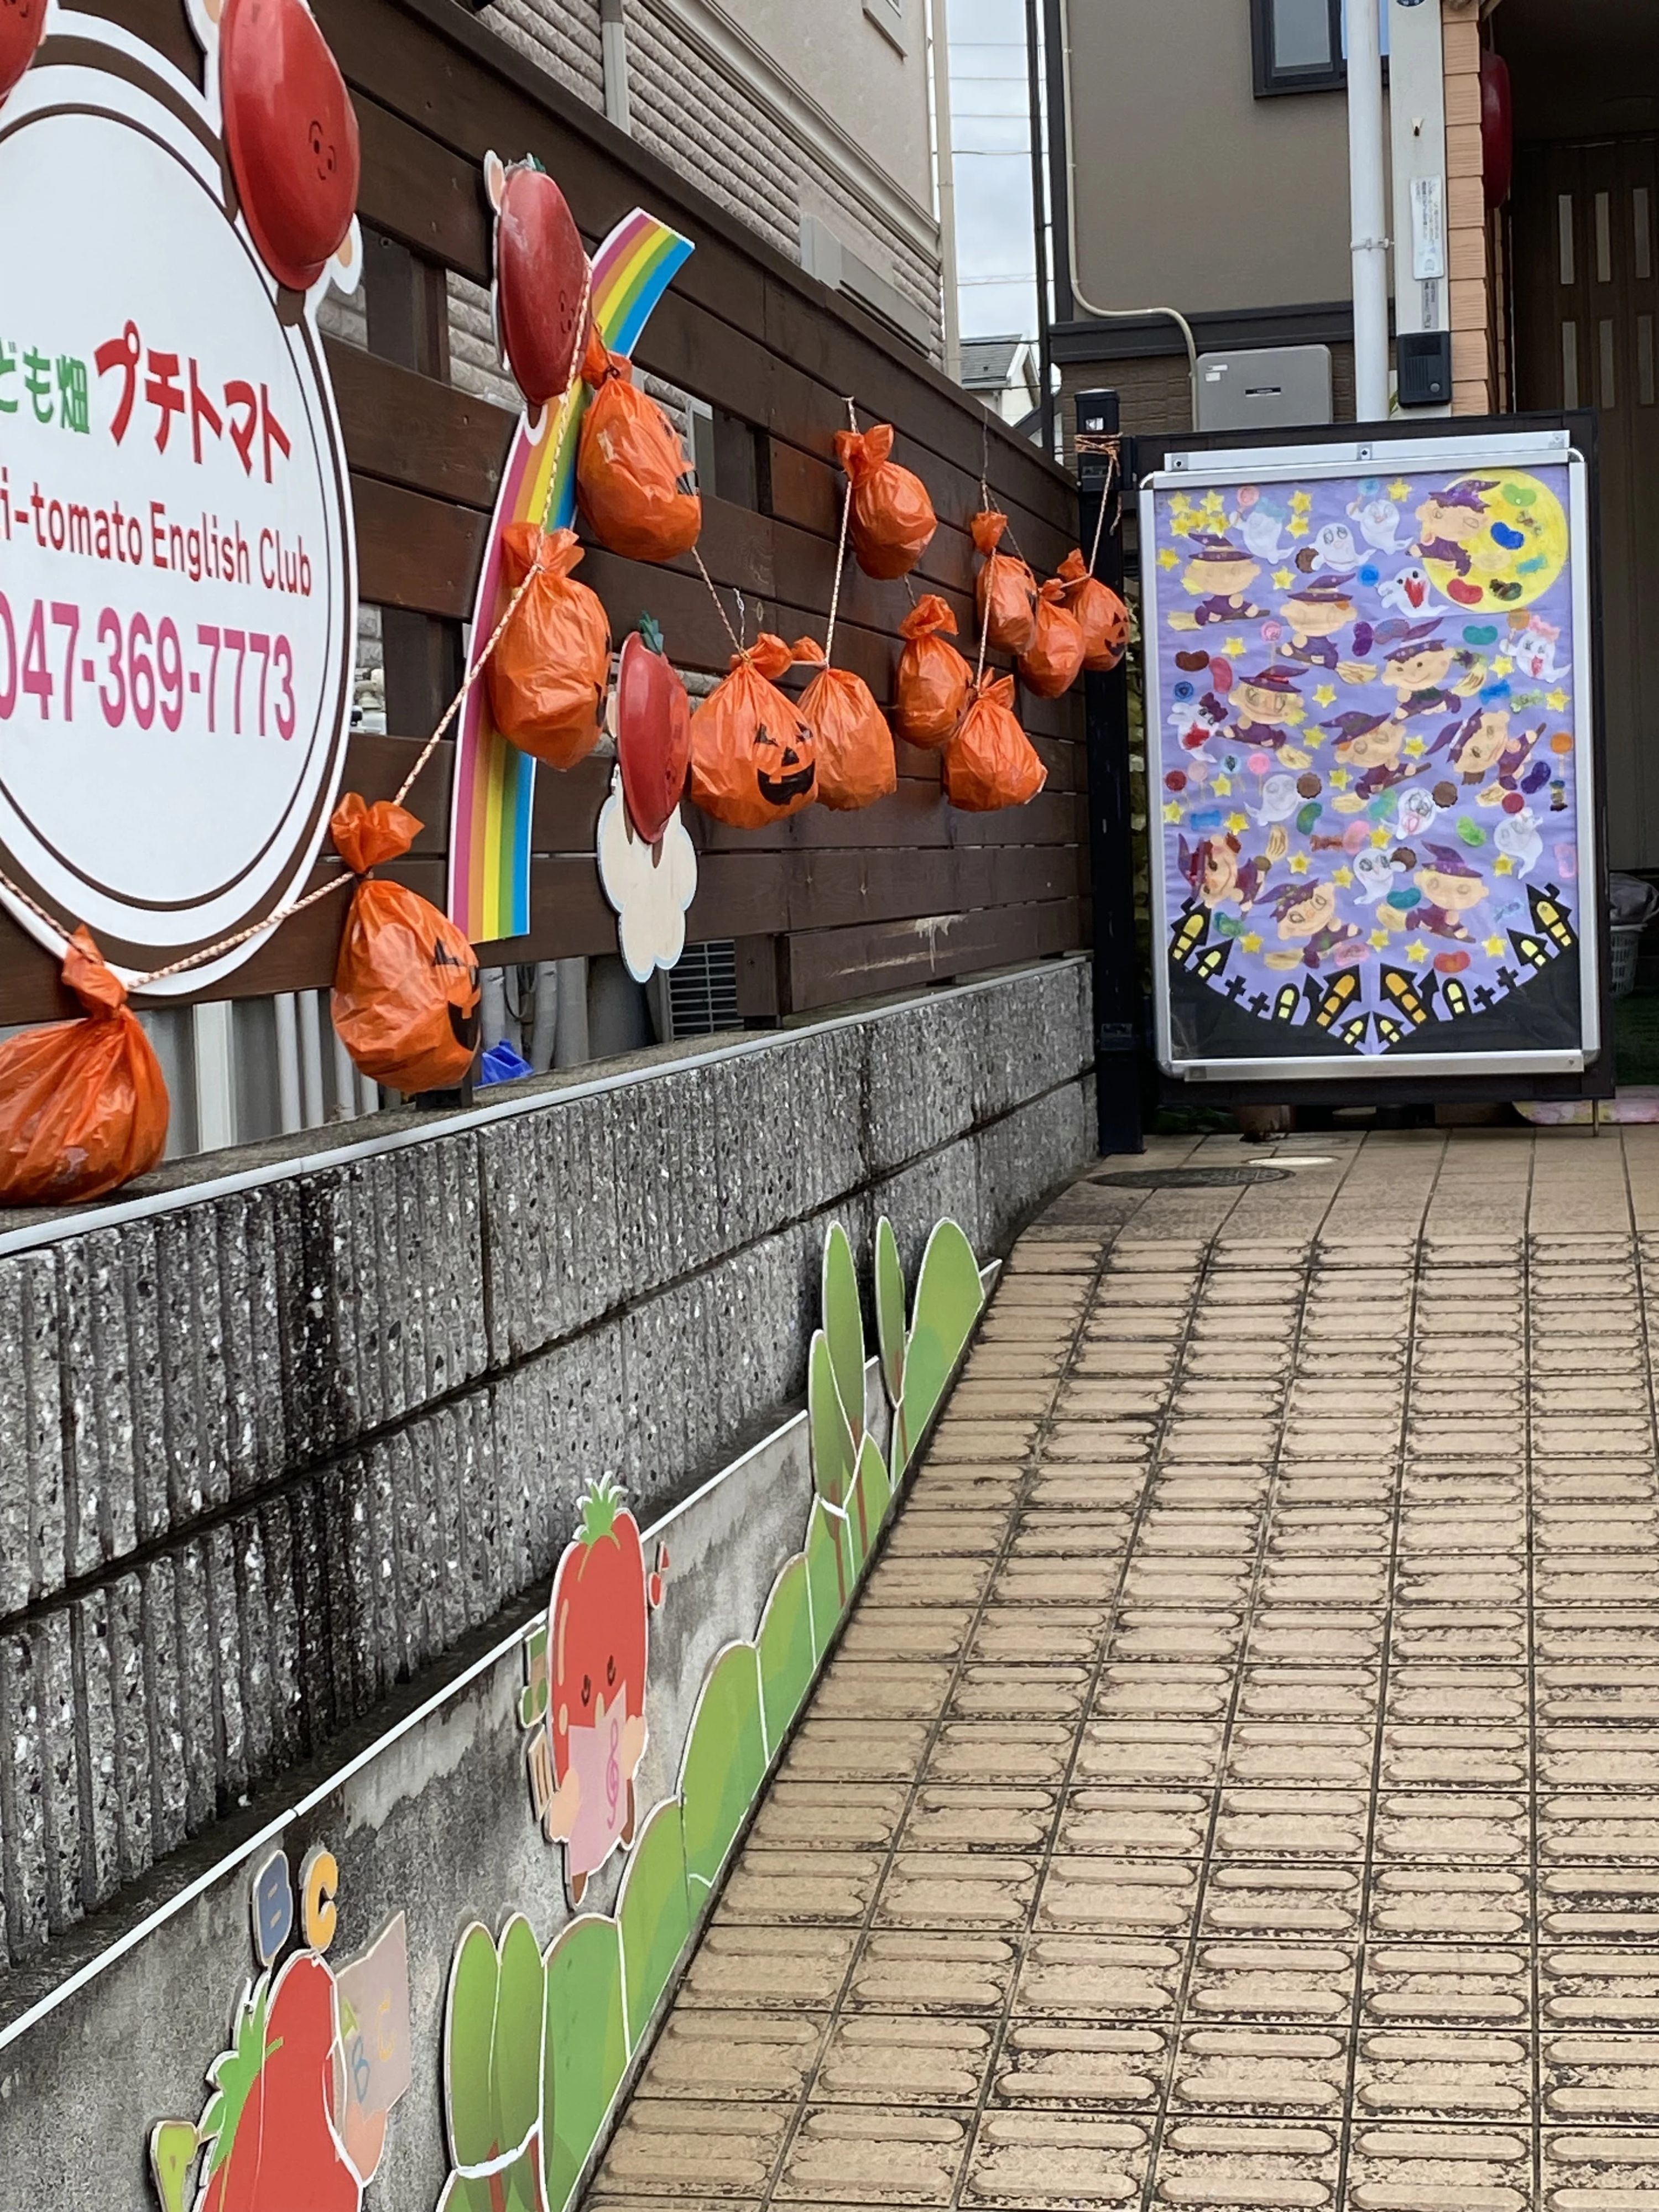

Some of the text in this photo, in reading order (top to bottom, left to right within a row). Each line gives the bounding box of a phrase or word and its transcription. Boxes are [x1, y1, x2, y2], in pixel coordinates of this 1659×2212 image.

[95, 320, 291, 484] プチトマト
[150, 500, 250, 582] English
[259, 528, 312, 597] Club
[0, 591, 296, 741] 047-369-7773
